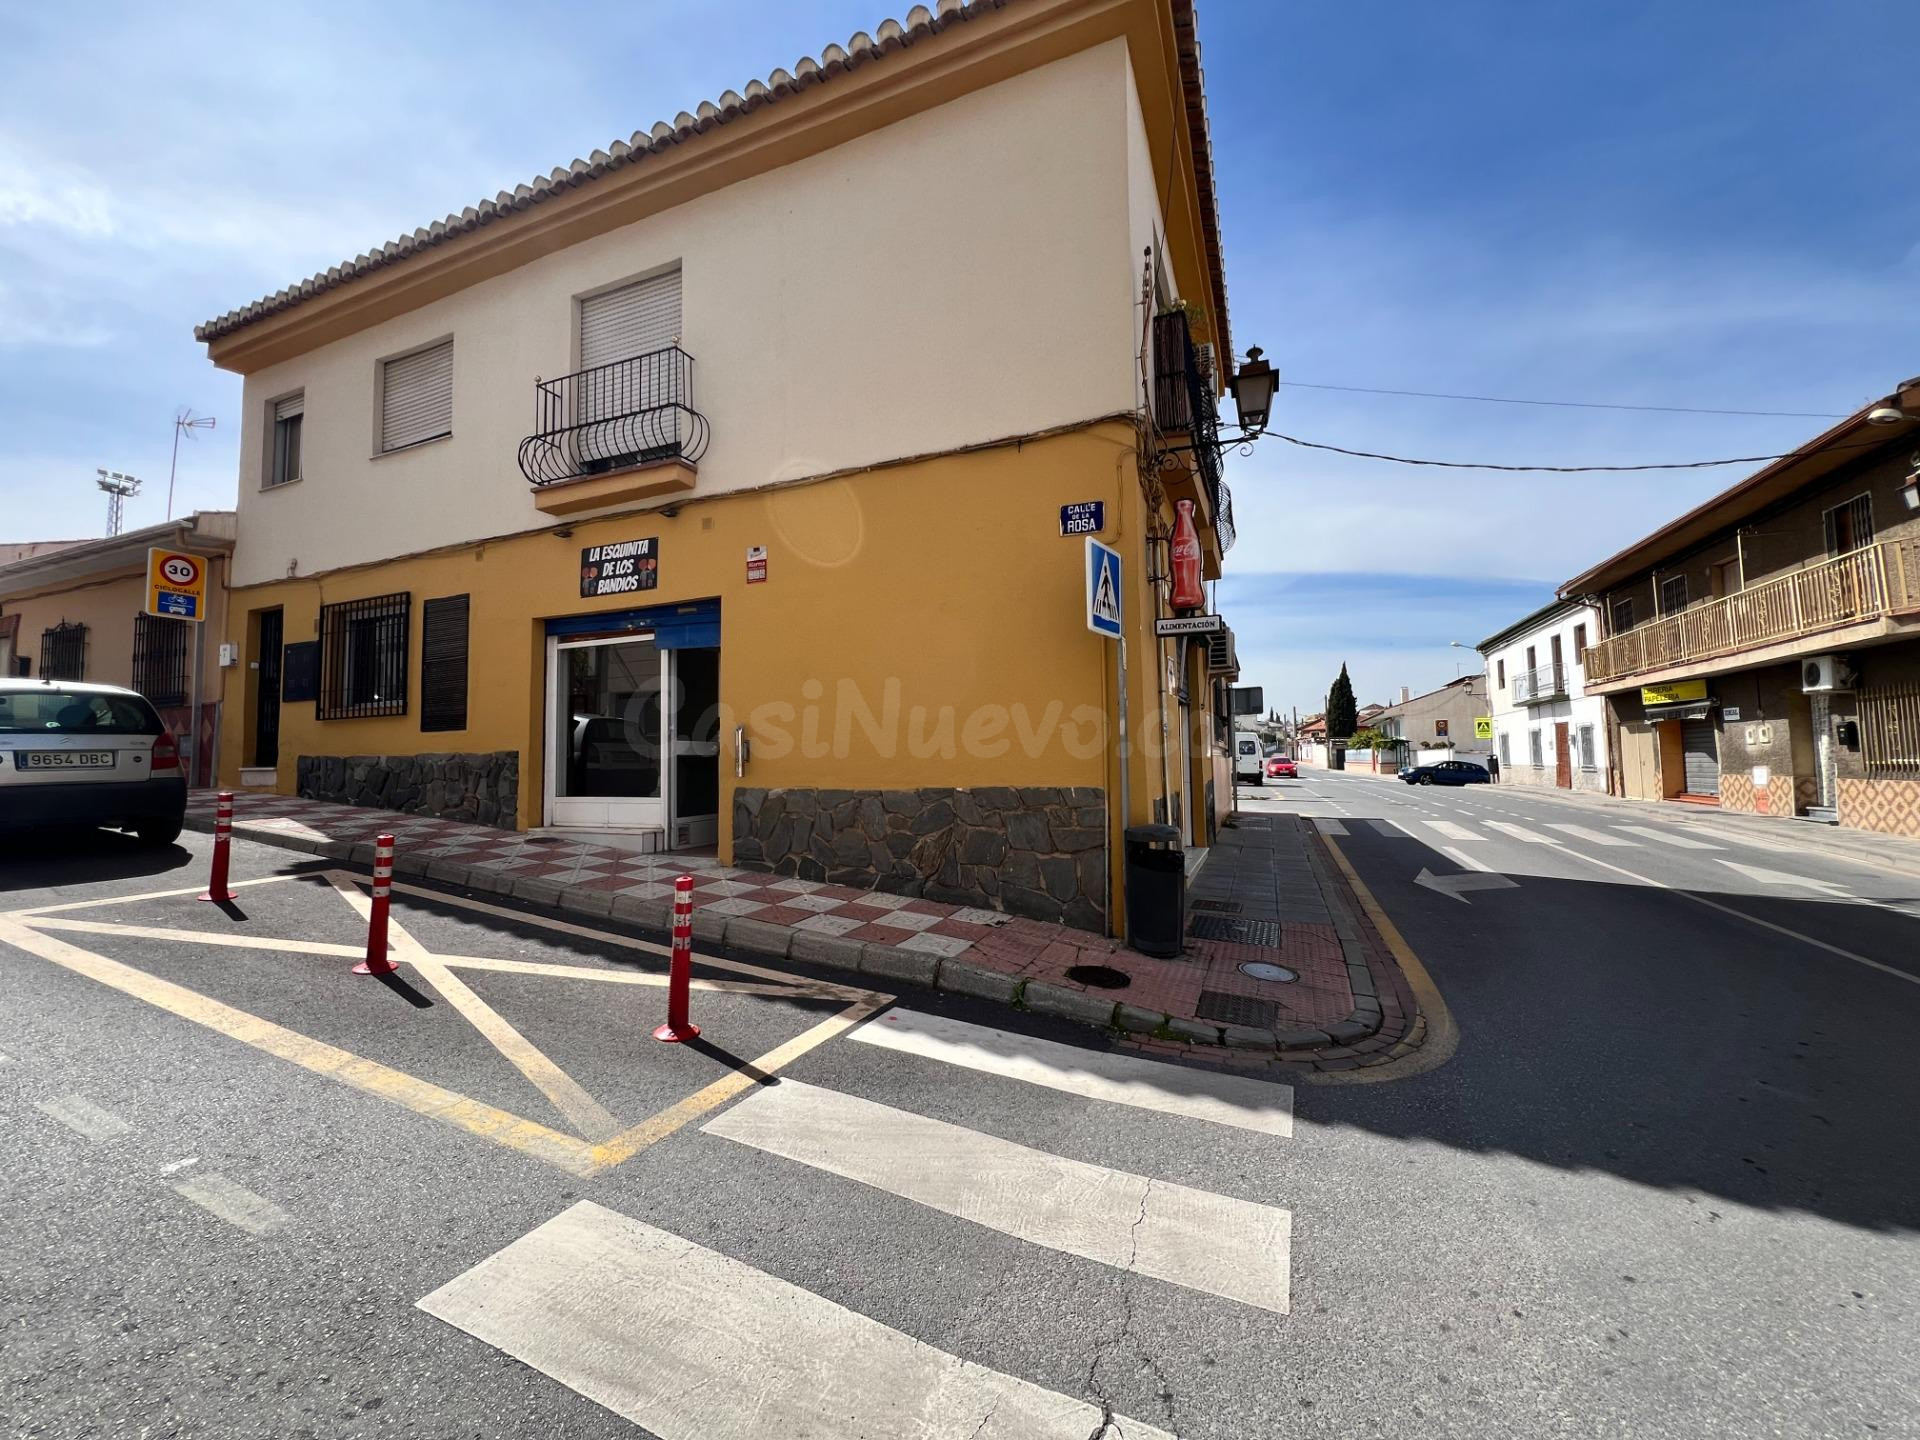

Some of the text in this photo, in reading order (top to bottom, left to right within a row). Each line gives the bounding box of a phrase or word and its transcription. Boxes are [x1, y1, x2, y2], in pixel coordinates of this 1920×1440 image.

[1067, 503, 1096, 514] CALLE
[1067, 518, 1096, 533] ROSA
[589, 540, 649, 562] LA ESQUINITA
[168, 564, 190, 577] 30
[602, 559, 634, 577] DE LOS
[154, 584, 201, 596] CICLOCALLE
[597, 575, 639, 595] BANDIOS
[1159, 620, 1216, 631] ALIMENTACIÓN
[31, 752, 110, 766] 9654 DBC
